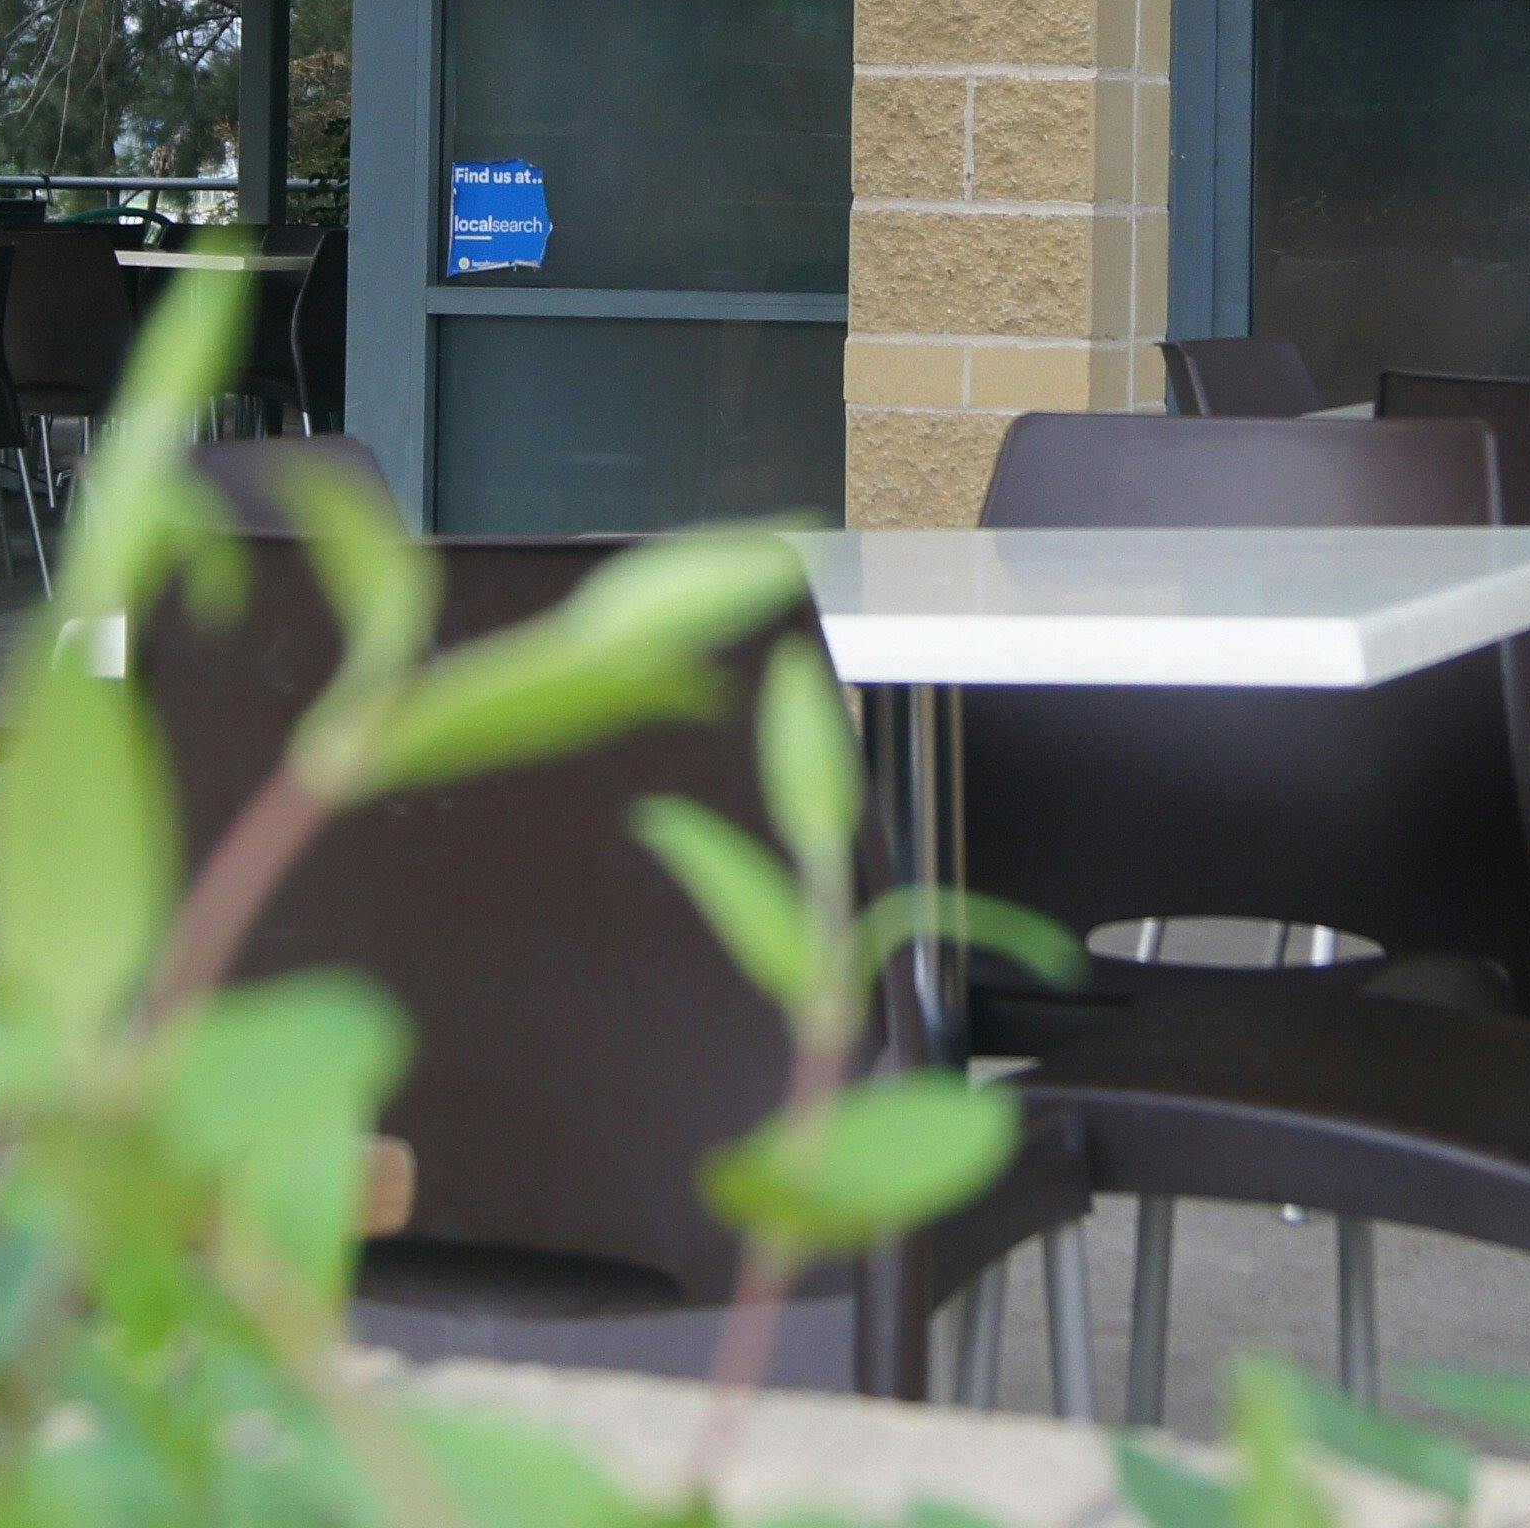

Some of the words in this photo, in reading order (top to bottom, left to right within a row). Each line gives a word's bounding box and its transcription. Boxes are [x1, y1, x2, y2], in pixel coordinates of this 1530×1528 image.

[454, 167, 489, 184] Find
[493, 172, 512, 184] us
[454, 215, 543, 233] localsearch
